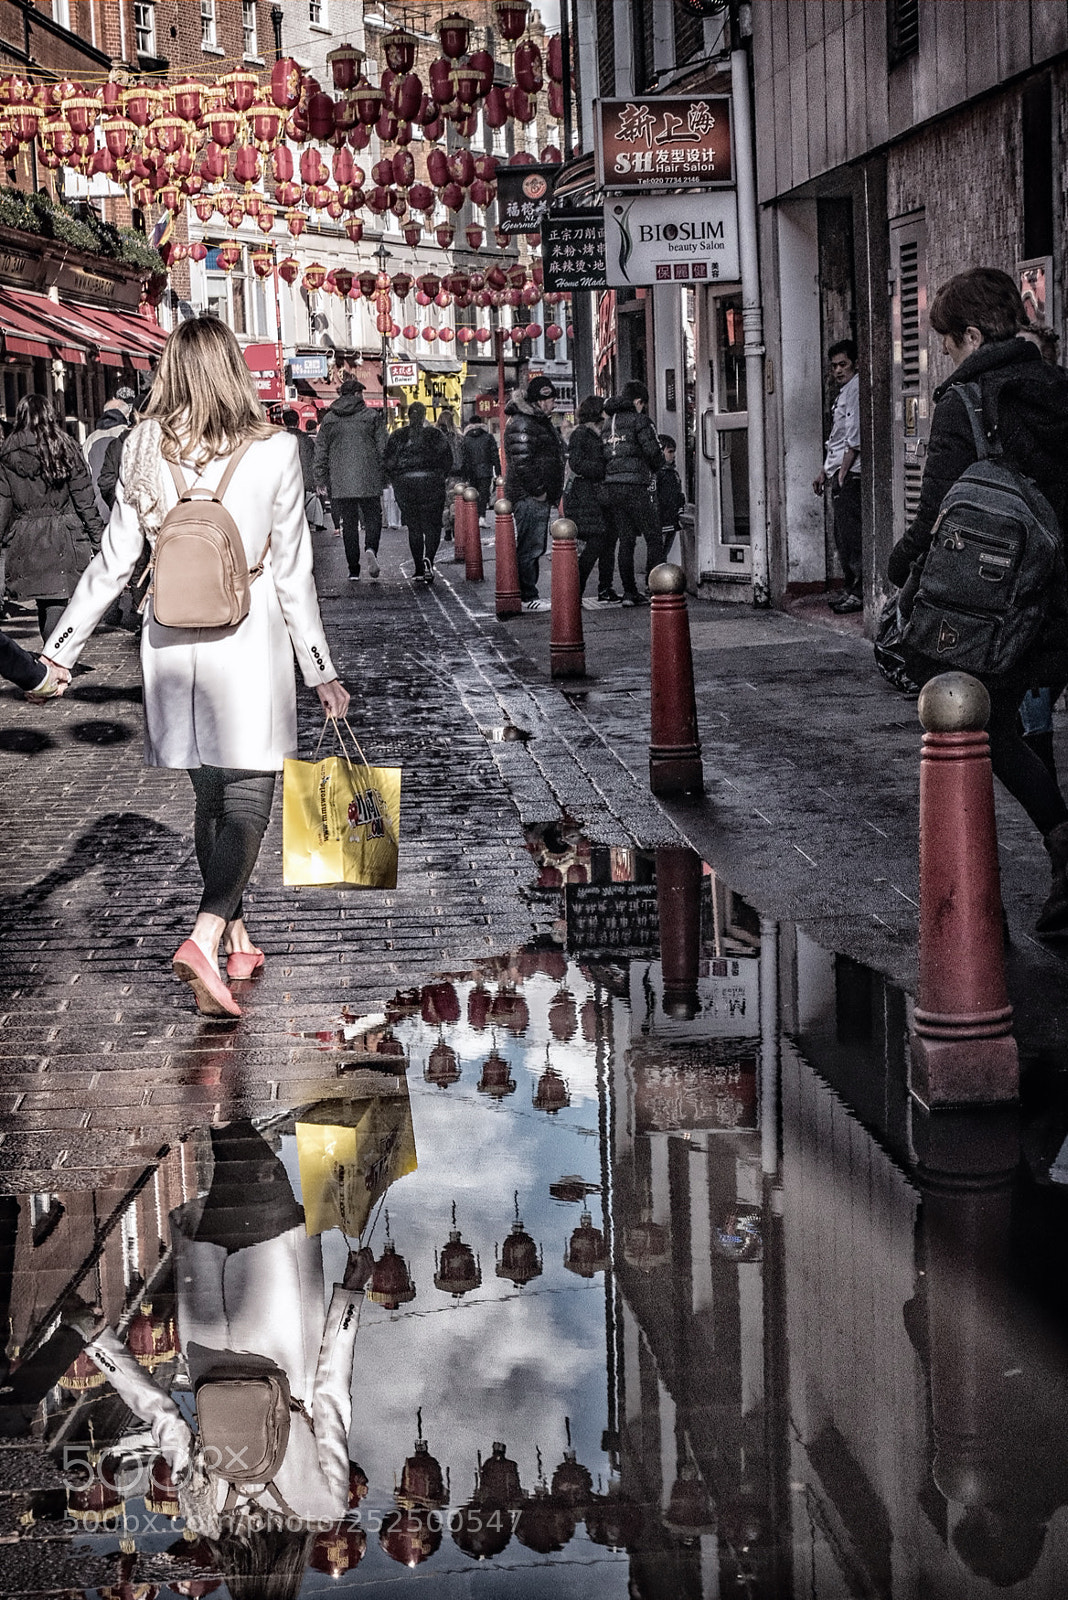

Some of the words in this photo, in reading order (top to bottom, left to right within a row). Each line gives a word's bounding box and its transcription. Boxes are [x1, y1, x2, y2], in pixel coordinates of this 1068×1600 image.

[614, 101, 716, 149] 新上海
[655, 148, 716, 163] 发型设计
[614, 151, 655, 174] SH
[656, 164, 679, 173] Hair
[683, 162, 715, 172] Salon
[665, 176, 682, 184] 7734
[638, 220, 725, 243] BIOSLIM
[668, 242, 698, 253] beauty
[699, 241, 725, 251] Salon
[555, 278, 579, 288] Home
[579, 277, 606, 287] Made
